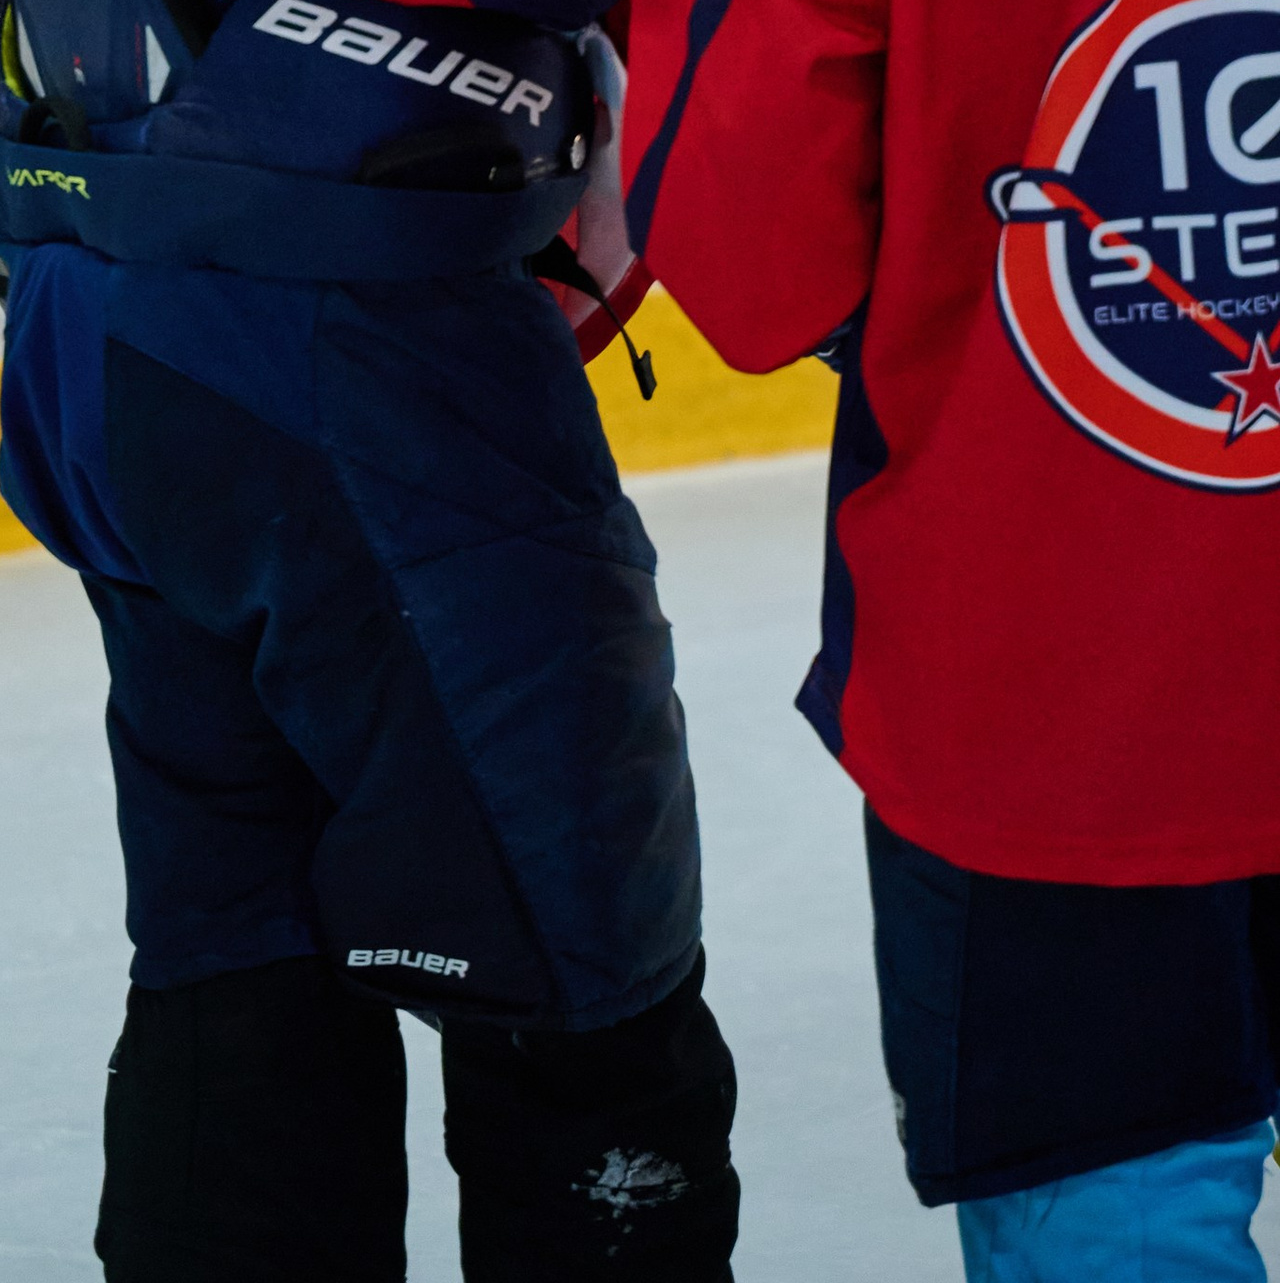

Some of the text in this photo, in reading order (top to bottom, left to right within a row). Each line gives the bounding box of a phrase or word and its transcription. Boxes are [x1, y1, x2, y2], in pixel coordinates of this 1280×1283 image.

[1134, 52, 1280, 191] 10
[1093, 292, 1280, 326] ELITE HOCKEY
[346, 948, 469, 979] BAUER
